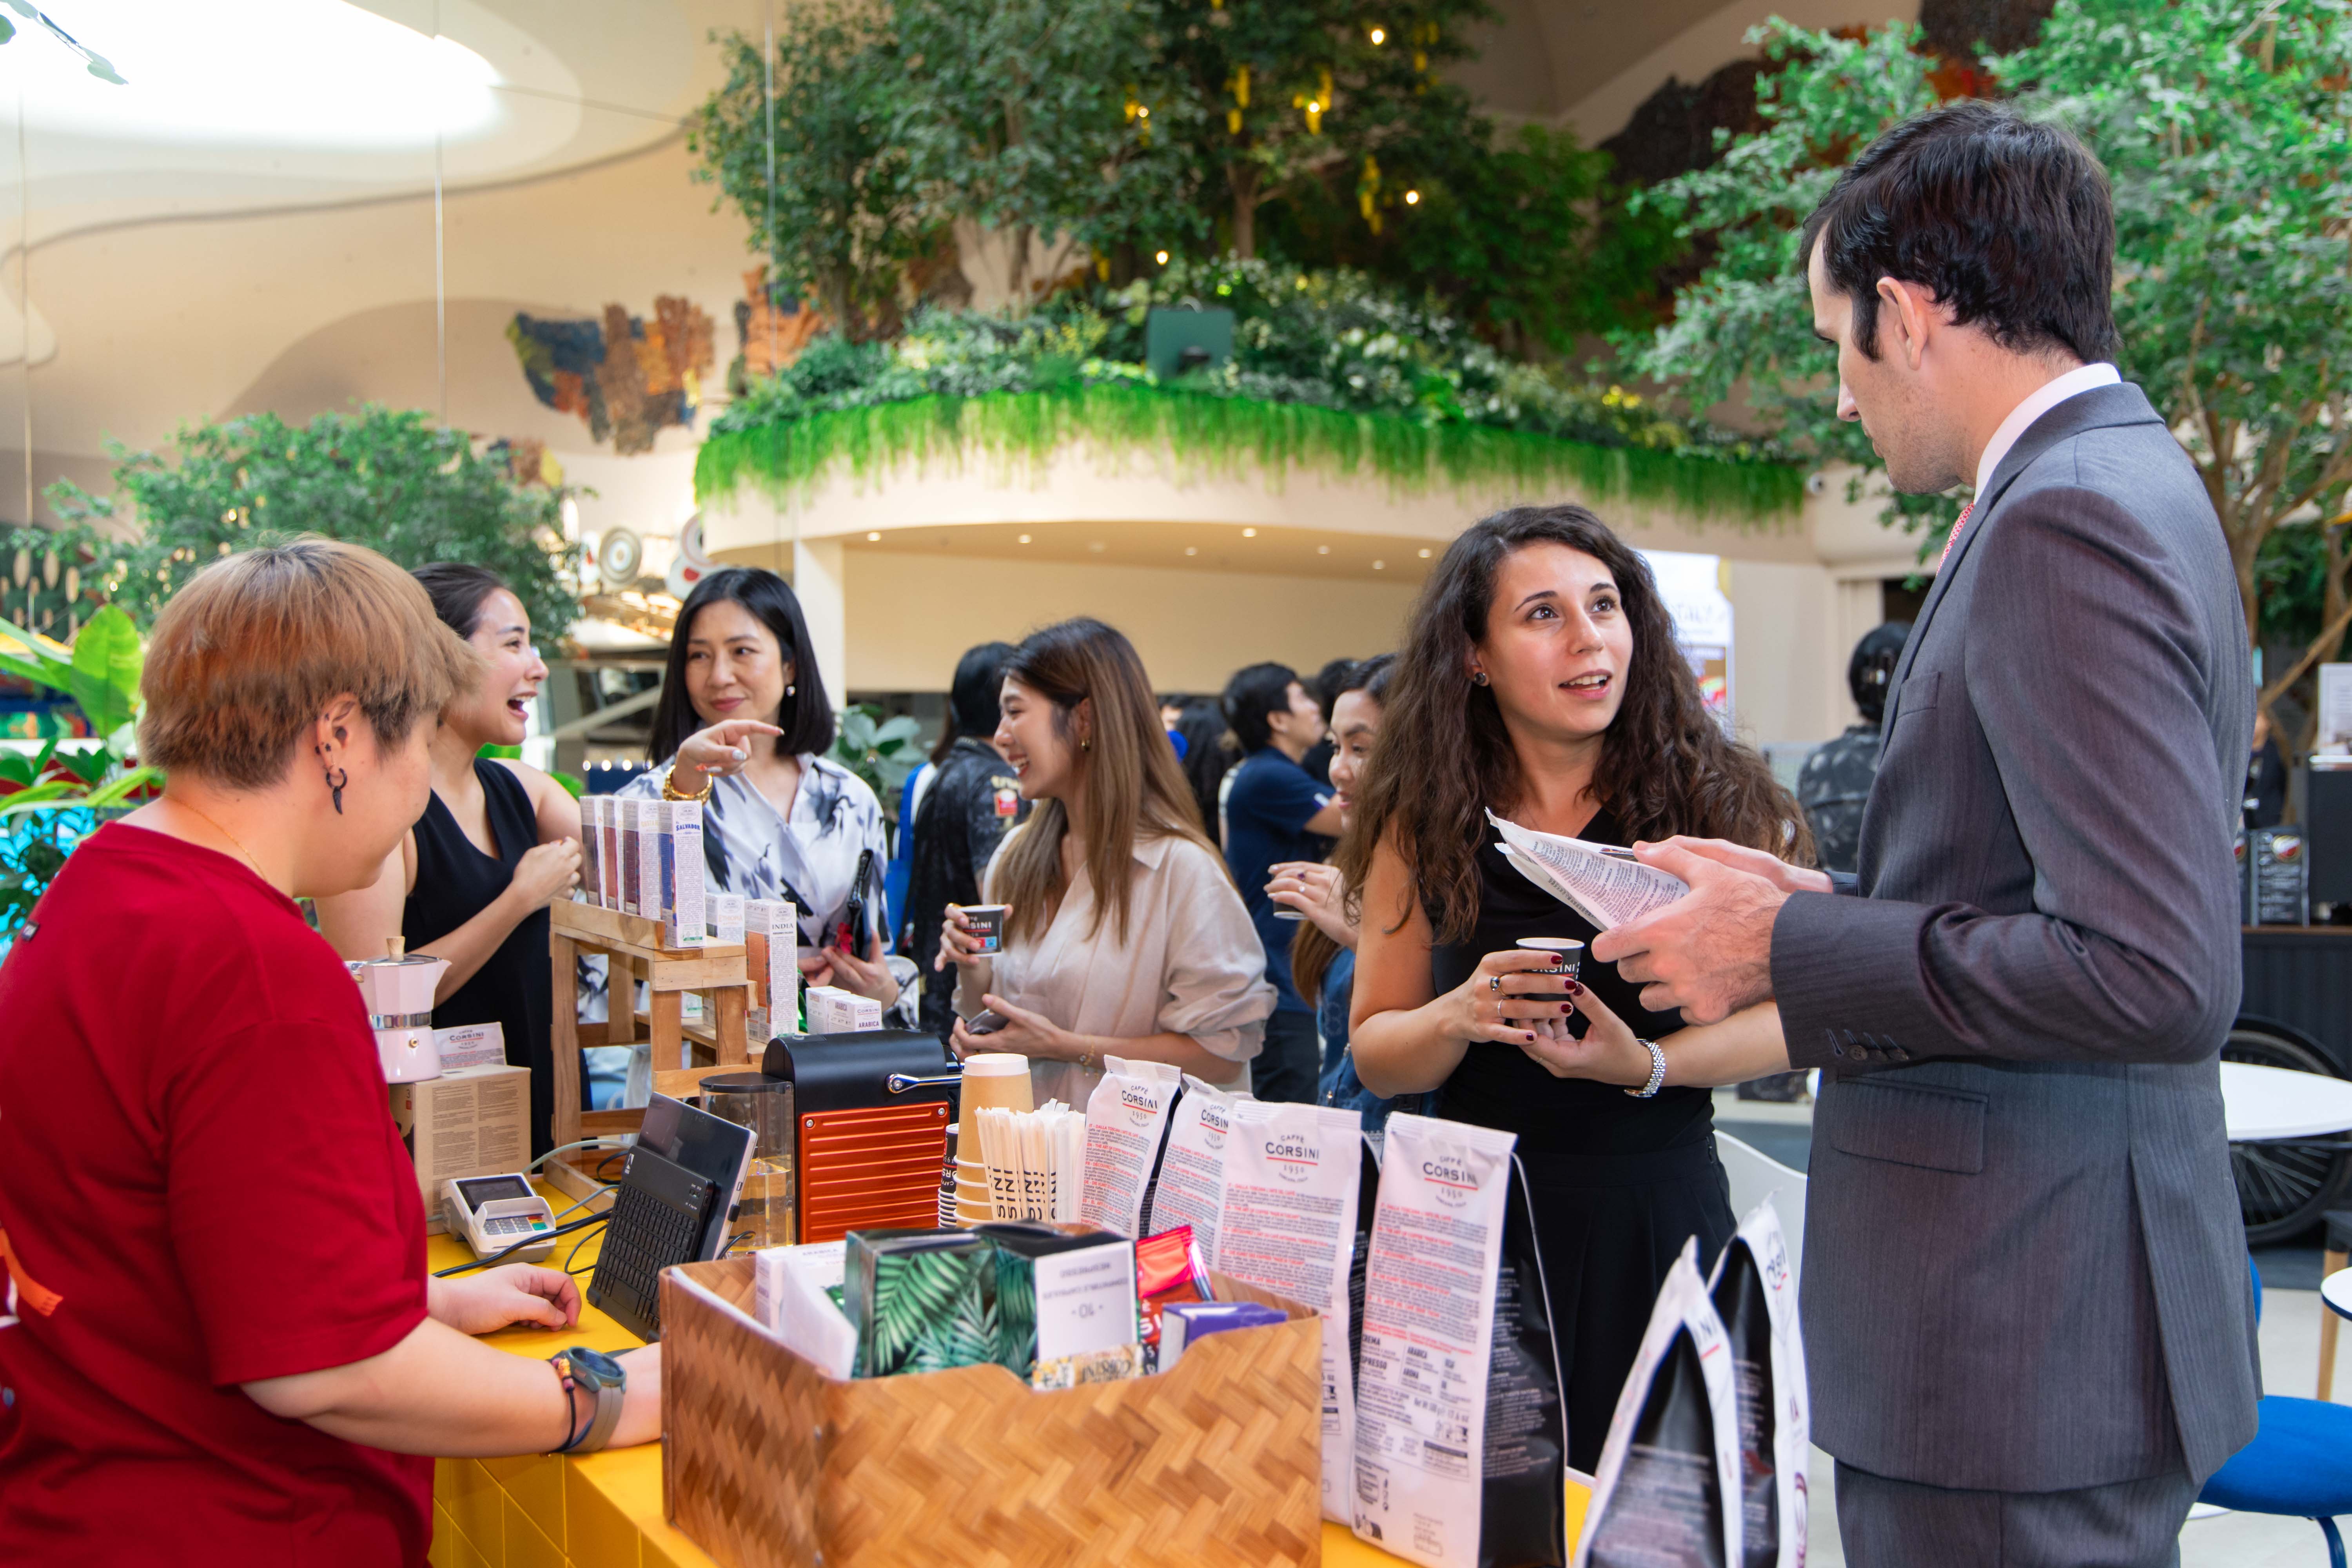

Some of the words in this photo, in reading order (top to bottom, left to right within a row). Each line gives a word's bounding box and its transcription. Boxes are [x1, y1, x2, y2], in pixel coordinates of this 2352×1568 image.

[1627, 882, 1637, 898] ARABICA
[1641, 903, 1651, 916] ATURAL
[835, 1001, 847, 1011] ARABICA
[450, 1032, 484, 1041] CORSINI
[1131, 1085, 1149, 1094] CAFFÈ
[1122, 1090, 1158, 1109] CORSINI
[1132, 1111, 1147, 1120] 1950
[1201, 1109, 1229, 1129] CORSIN
[1280, 1134, 1304, 1143] CAFFÈ
[1265, 1142, 1319, 1160] CORSINI
[1283, 1164, 1304, 1174] 1950
